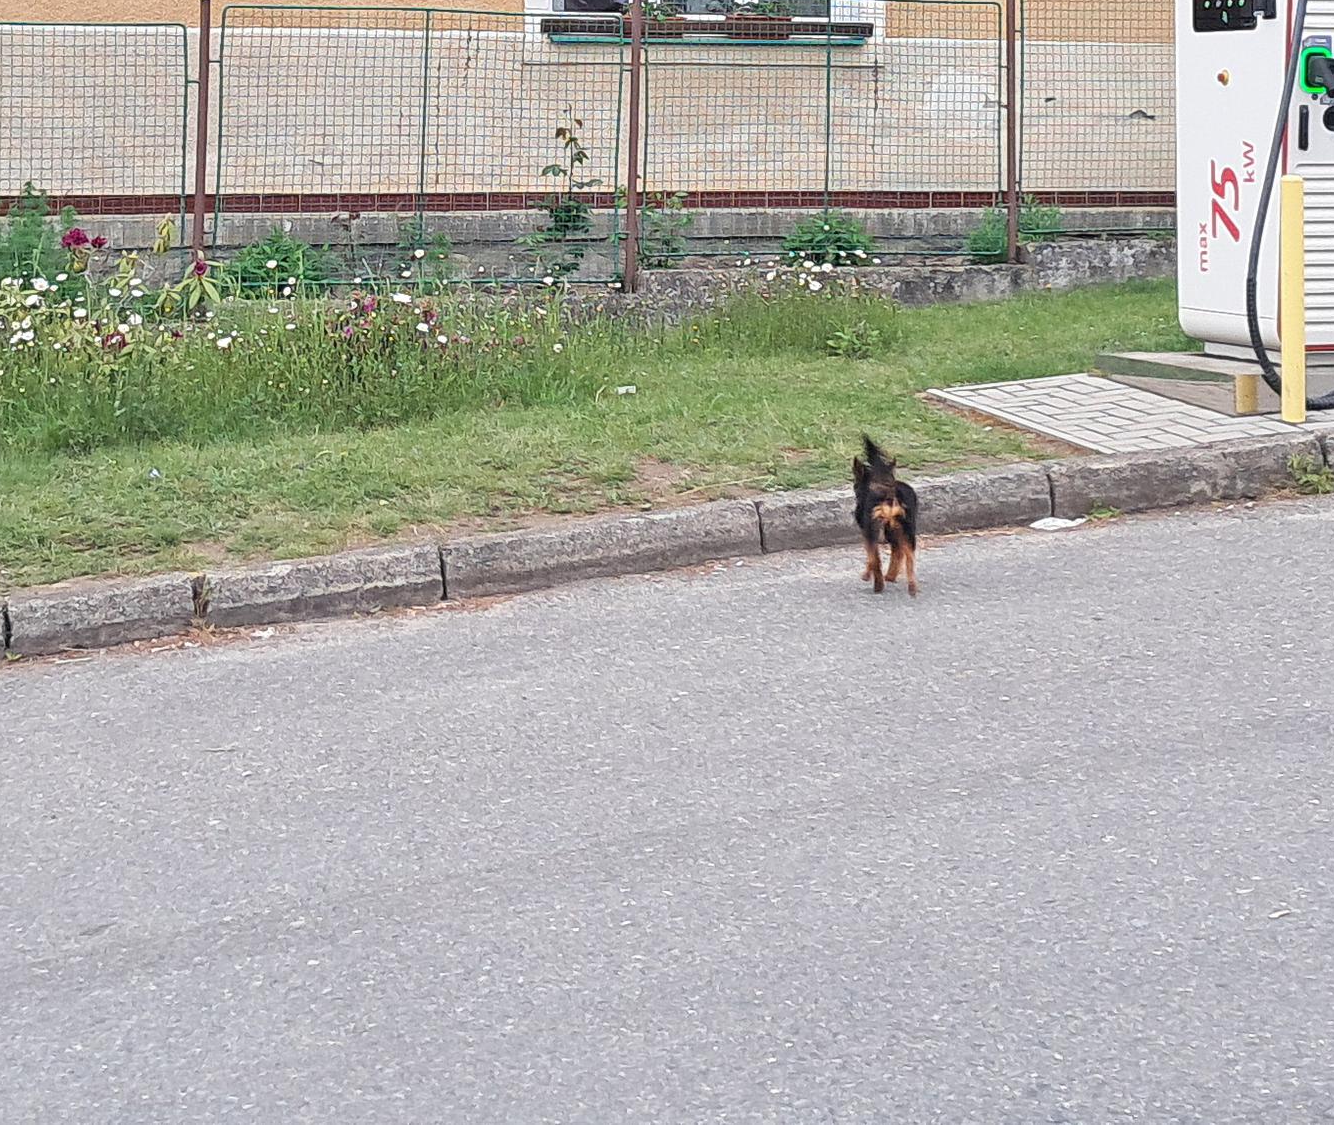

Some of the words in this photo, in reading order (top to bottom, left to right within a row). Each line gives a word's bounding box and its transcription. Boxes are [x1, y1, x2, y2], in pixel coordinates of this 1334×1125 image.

[1199, 222, 1208, 272] max
[1210, 159, 1240, 242] 75
[1242, 140, 1255, 183] kW
